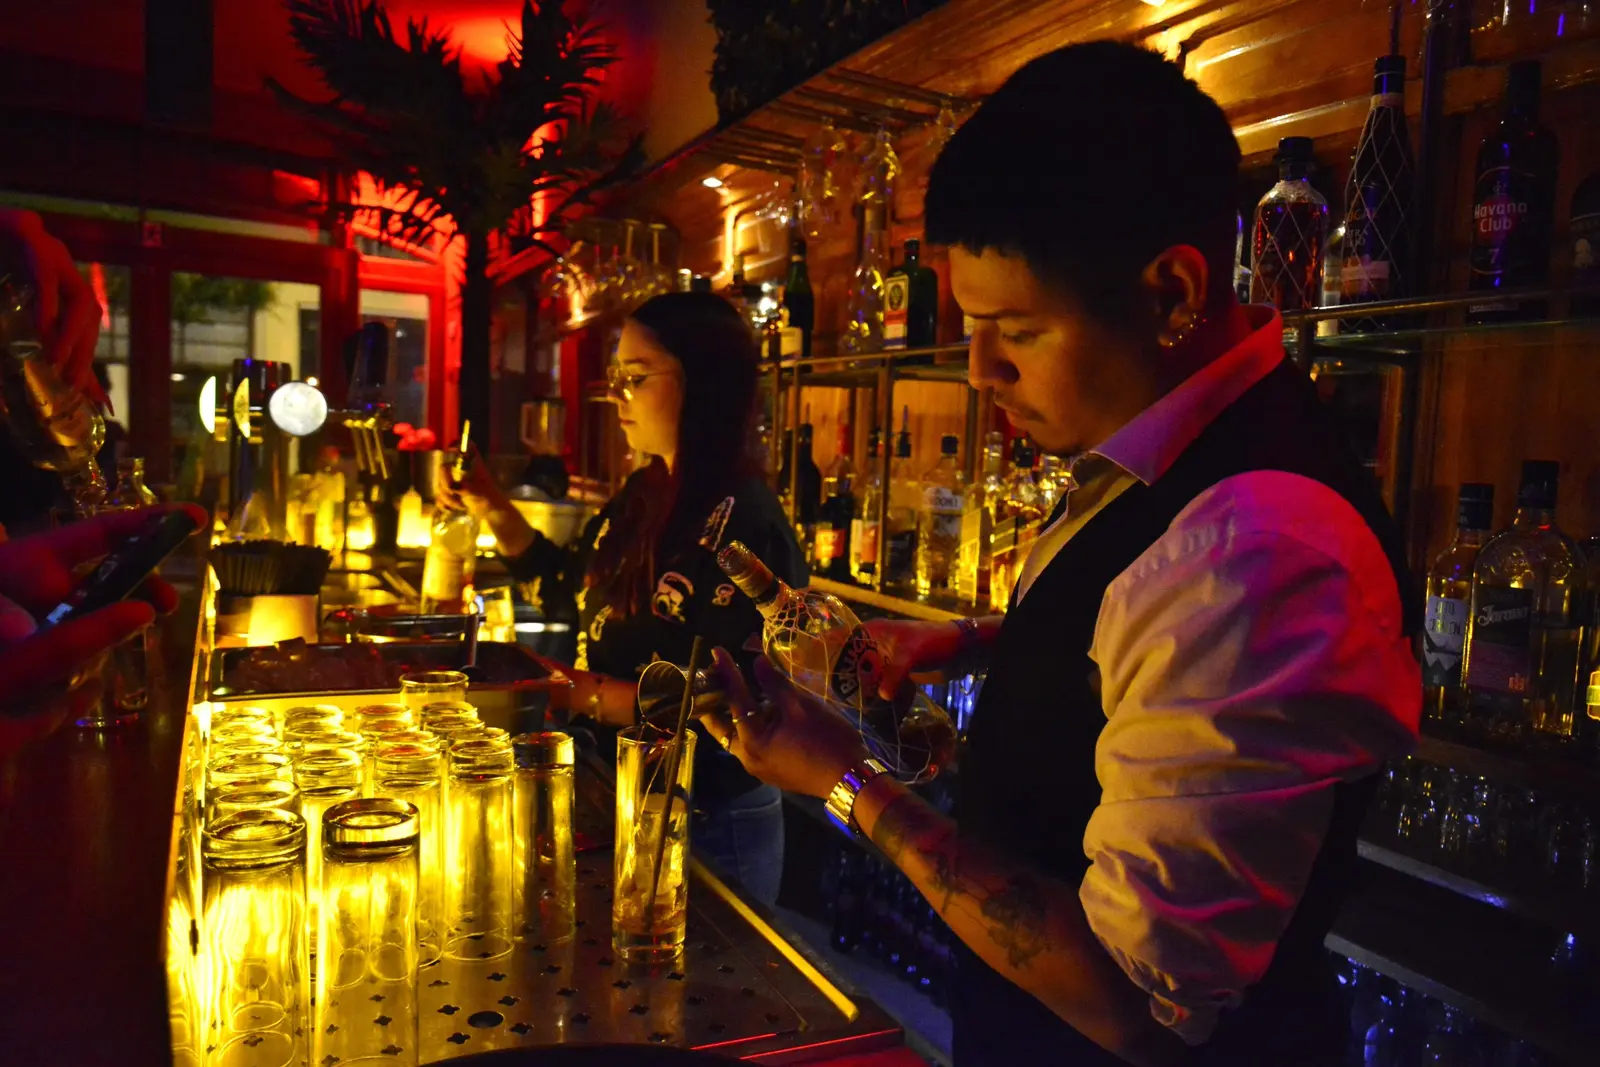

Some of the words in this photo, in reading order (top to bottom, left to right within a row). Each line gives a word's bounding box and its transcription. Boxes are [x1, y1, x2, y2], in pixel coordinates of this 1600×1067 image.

[1474, 201, 1528, 219] Havana
[1479, 217, 1512, 233] Club
[1487, 246, 1501, 265] 7
